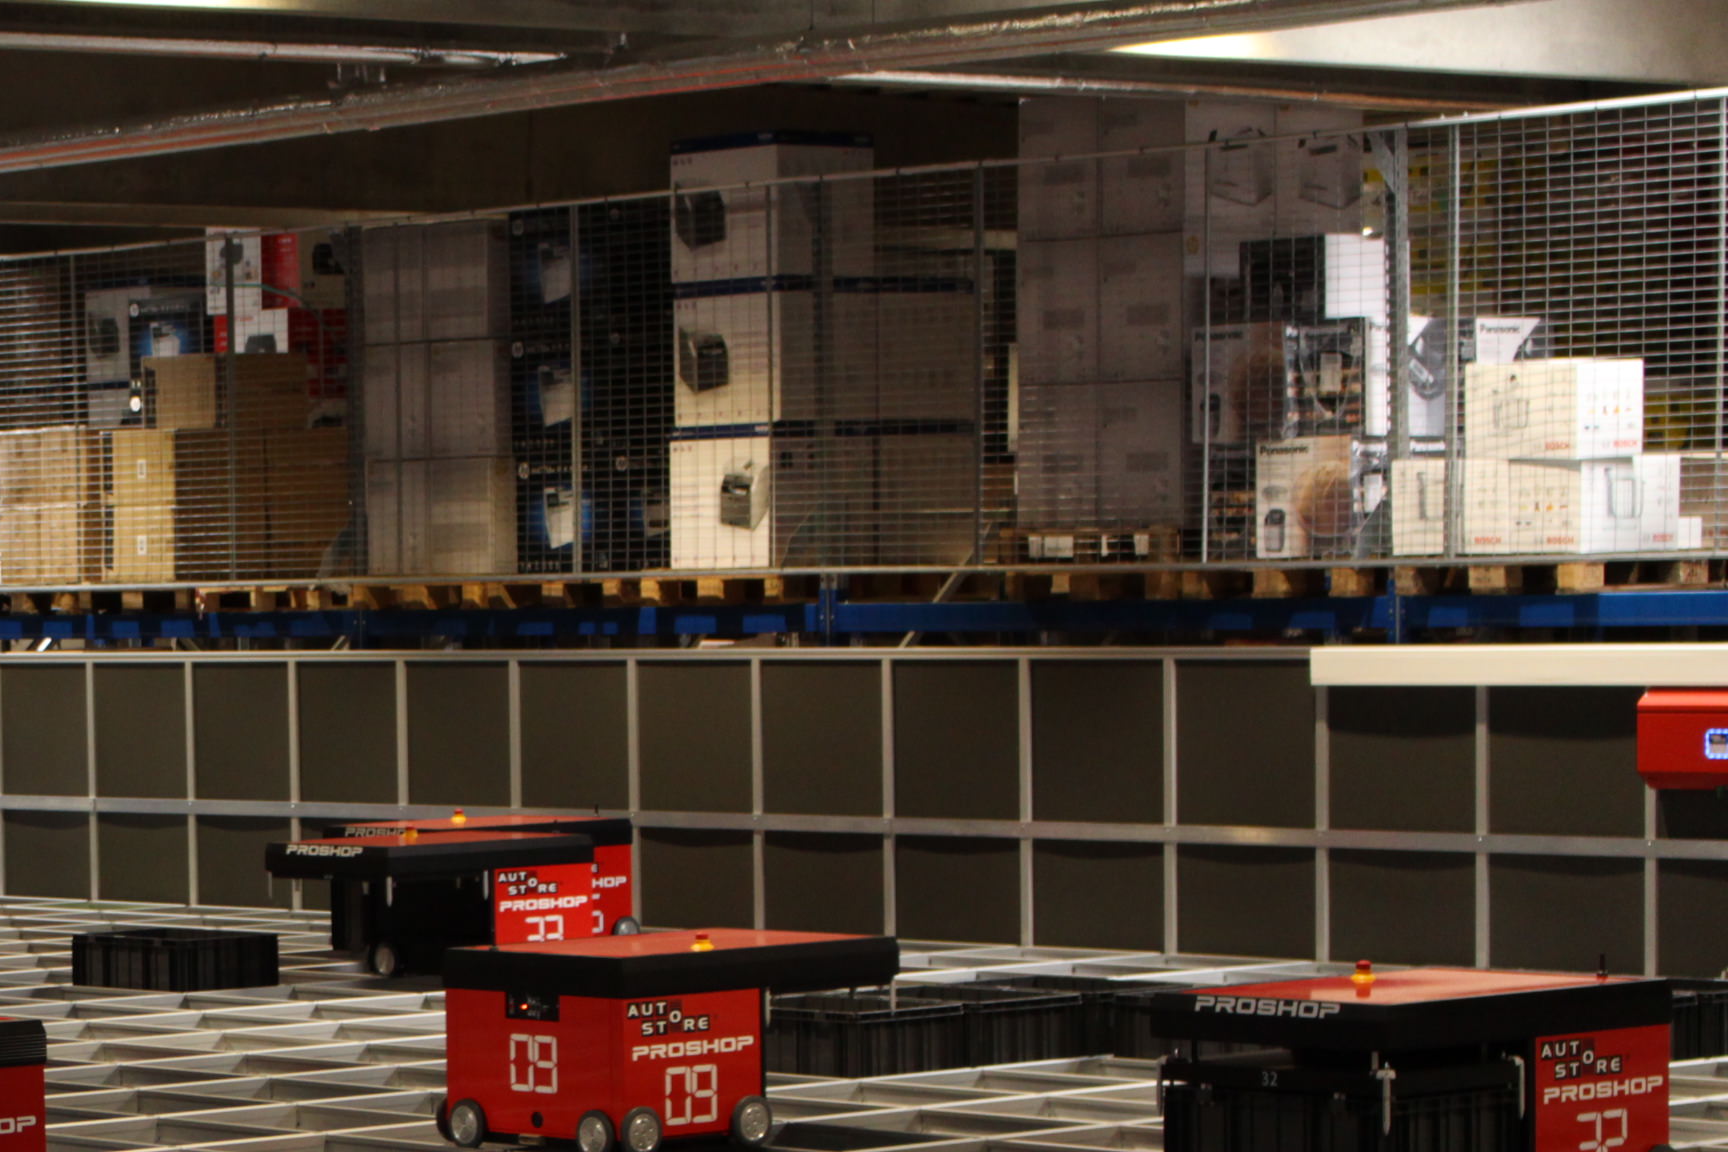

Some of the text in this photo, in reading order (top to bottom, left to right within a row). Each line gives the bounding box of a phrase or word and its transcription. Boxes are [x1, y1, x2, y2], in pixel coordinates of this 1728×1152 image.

[1260, 445, 1309, 455] Panasonic
[286, 844, 363, 857] PROSHOP
[499, 895, 589, 912] PROSHOP
[1194, 994, 1341, 1019] PROSHOP
[632, 1035, 754, 1061] PROSHOP
[509, 1032, 558, 1094] 09
[1262, 1071, 1278, 1087] 32
[1543, 1075, 1664, 1105] PROSHOP
[665, 1063, 718, 1126] 09
